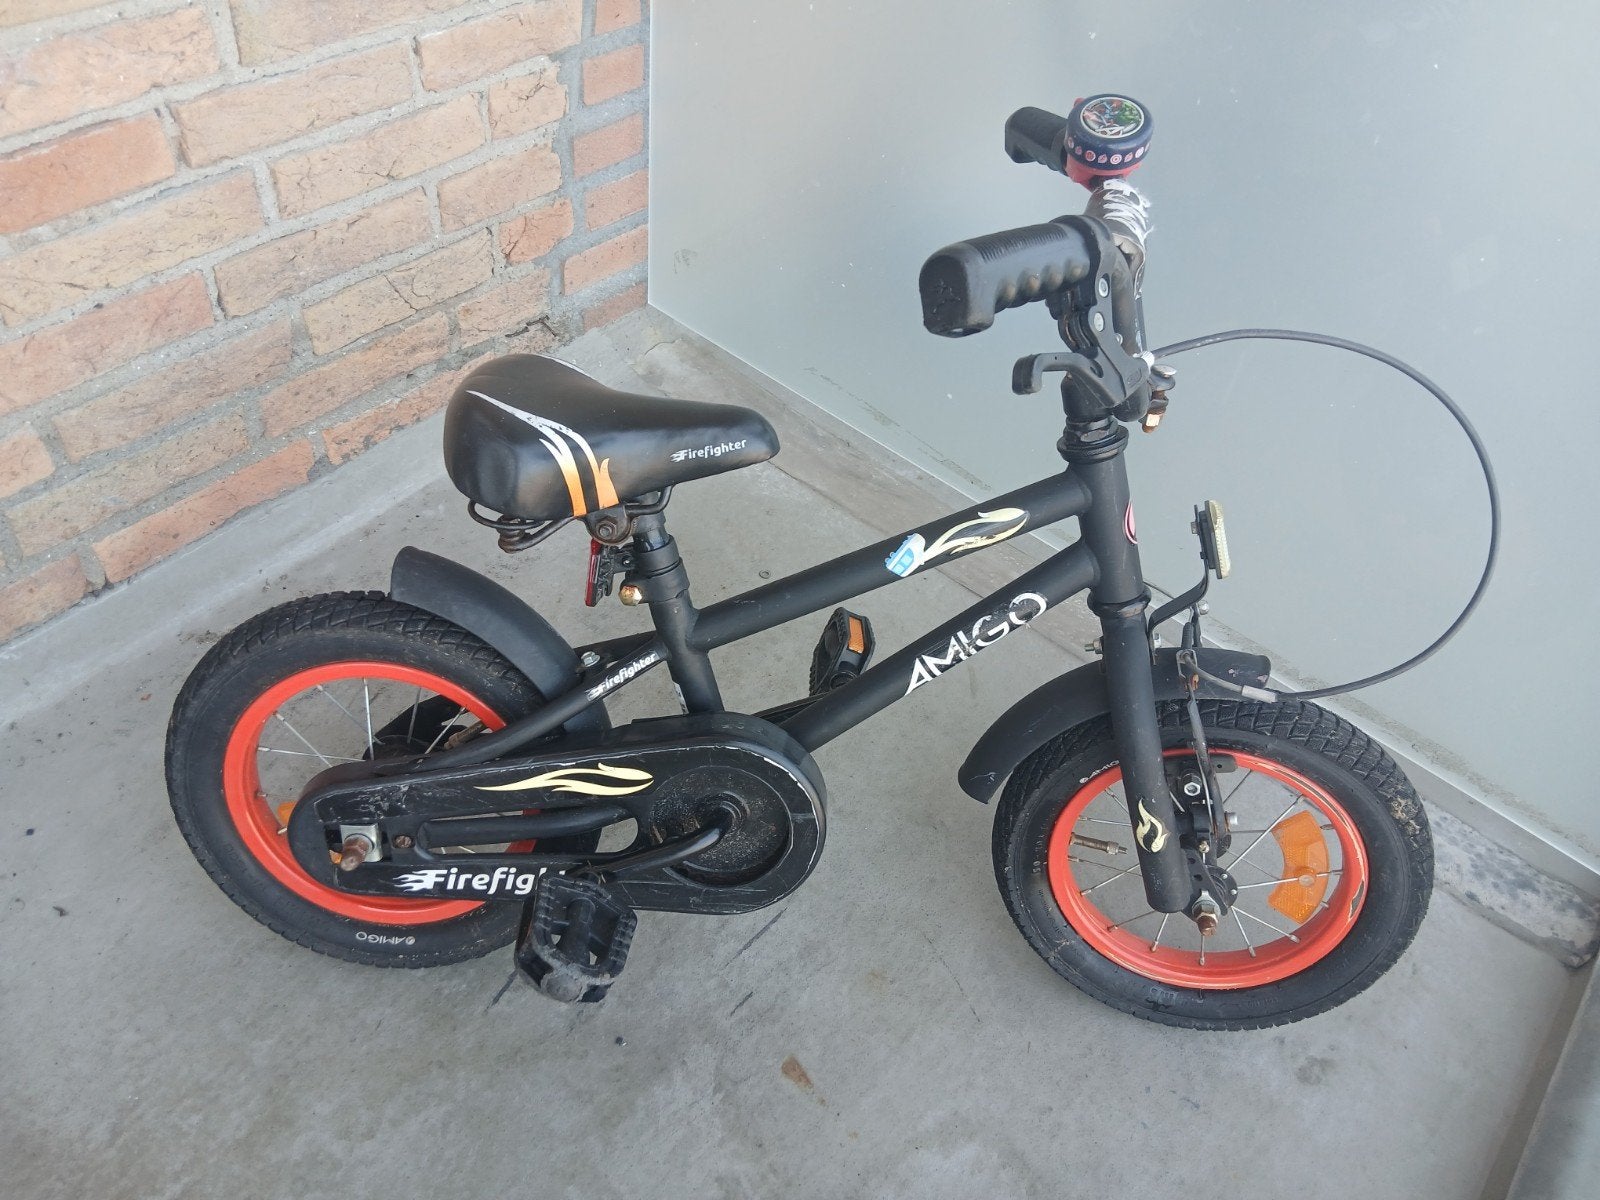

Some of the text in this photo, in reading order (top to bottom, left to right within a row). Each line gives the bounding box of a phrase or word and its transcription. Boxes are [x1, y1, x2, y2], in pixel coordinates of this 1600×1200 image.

[670, 439, 747, 463] Firefighter
[904, 591, 1048, 696] AMIGO
[585, 653, 656, 702] Firefighter
[393, 867, 566, 895] Firefig
[356, 931, 406, 945] AMIGO
